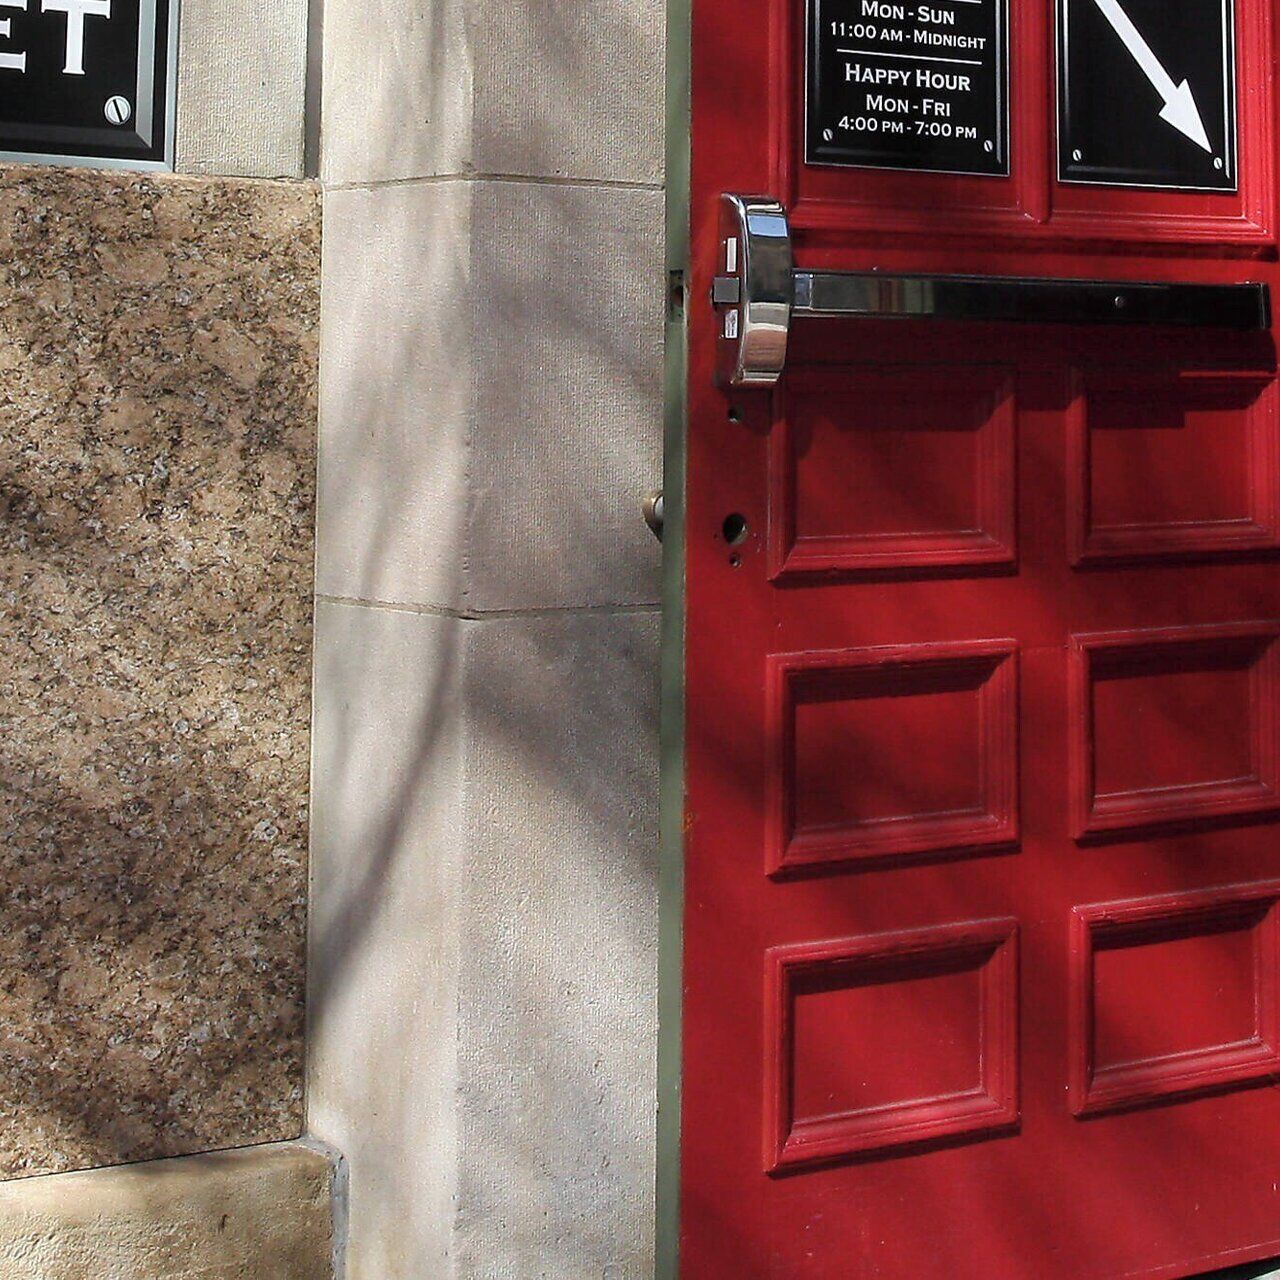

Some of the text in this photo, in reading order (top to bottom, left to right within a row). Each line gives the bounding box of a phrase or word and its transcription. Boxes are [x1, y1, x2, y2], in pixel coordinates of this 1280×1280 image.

[831, 21, 877, 39] 11:00
[880, 28, 903, 42] AM
[838, 115, 878, 132] 4:00
[882, 121, 904, 134] PM
[915, 121, 952, 137] 7:00
[955, 126, 977, 139] PM
